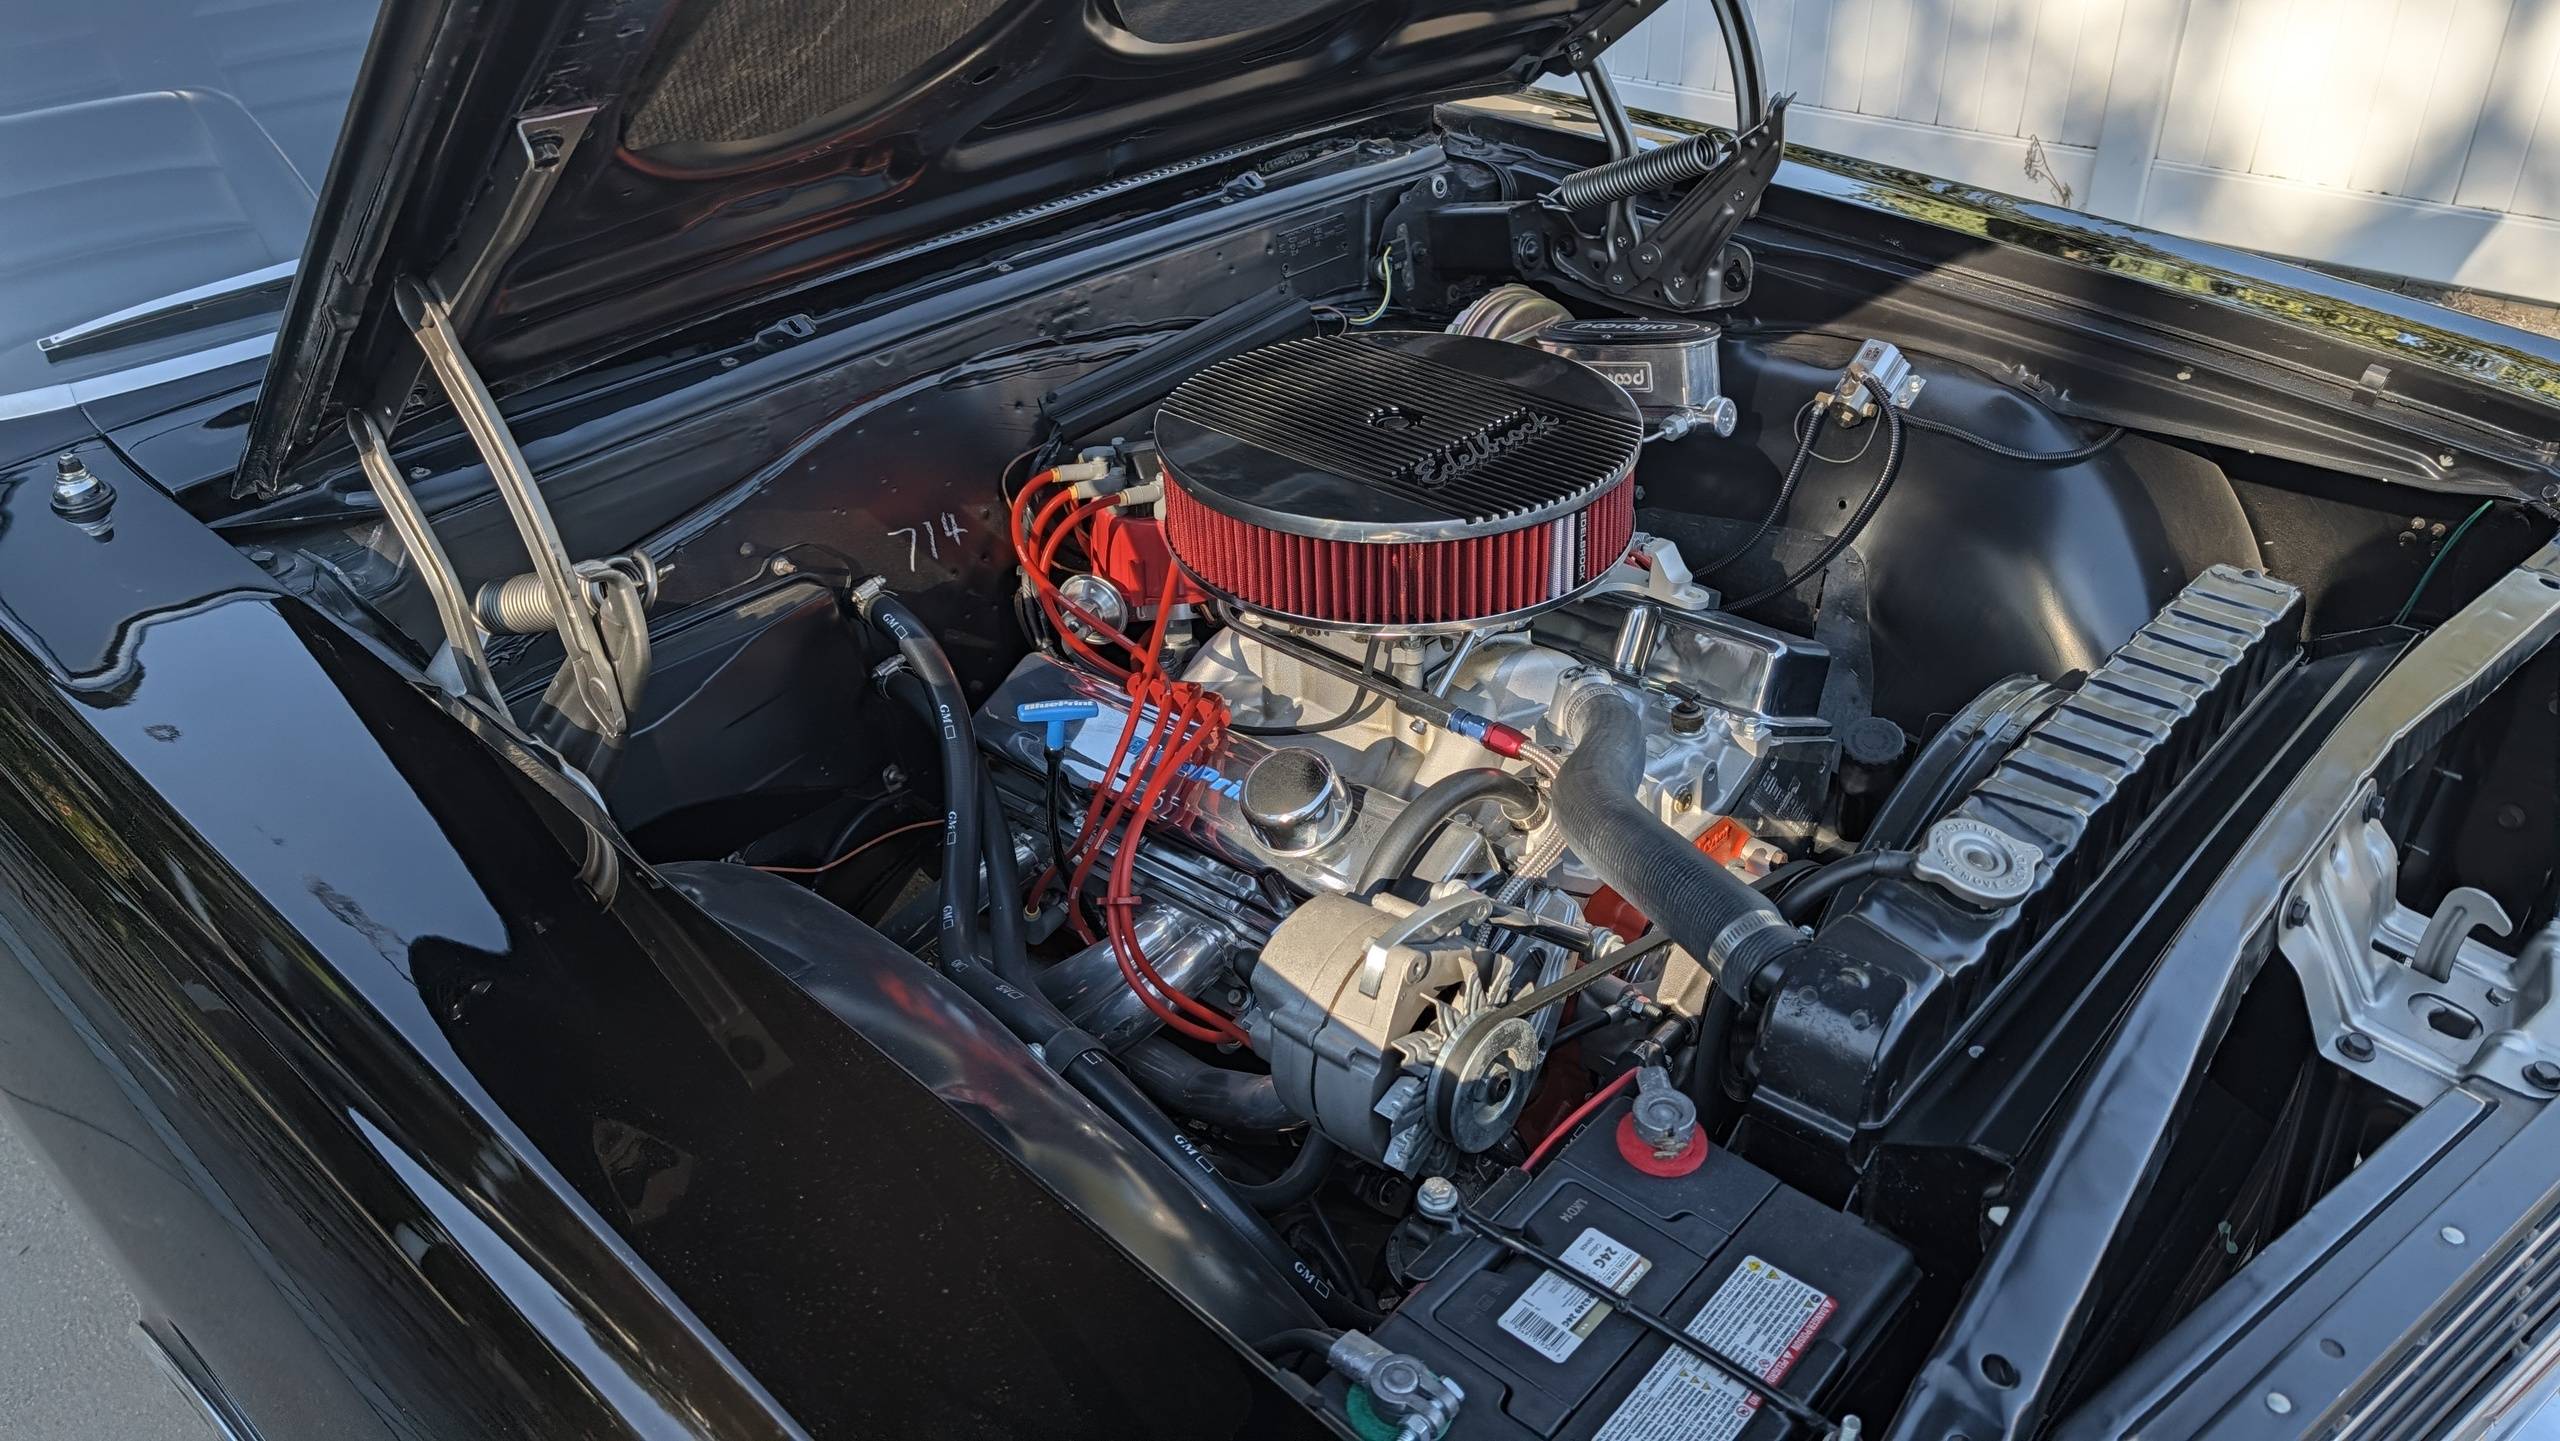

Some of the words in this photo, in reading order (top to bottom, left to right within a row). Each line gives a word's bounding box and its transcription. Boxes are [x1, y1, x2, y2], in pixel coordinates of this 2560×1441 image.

[1414, 411, 1560, 485] Edelbrock
[887, 511, 969, 573] 714
[1578, 511, 1588, 581] EDELBROCK
[882, 613, 899, 629] GM
[939, 703, 953, 724] GM
[1024, 700, 1094, 711] BluePrint
[947, 810, 958, 831] GM
[1174, 1134, 1199, 1156] GM
[1592, 1245, 1618, 1269] 24G
[1294, 1261, 1316, 1283] GM
